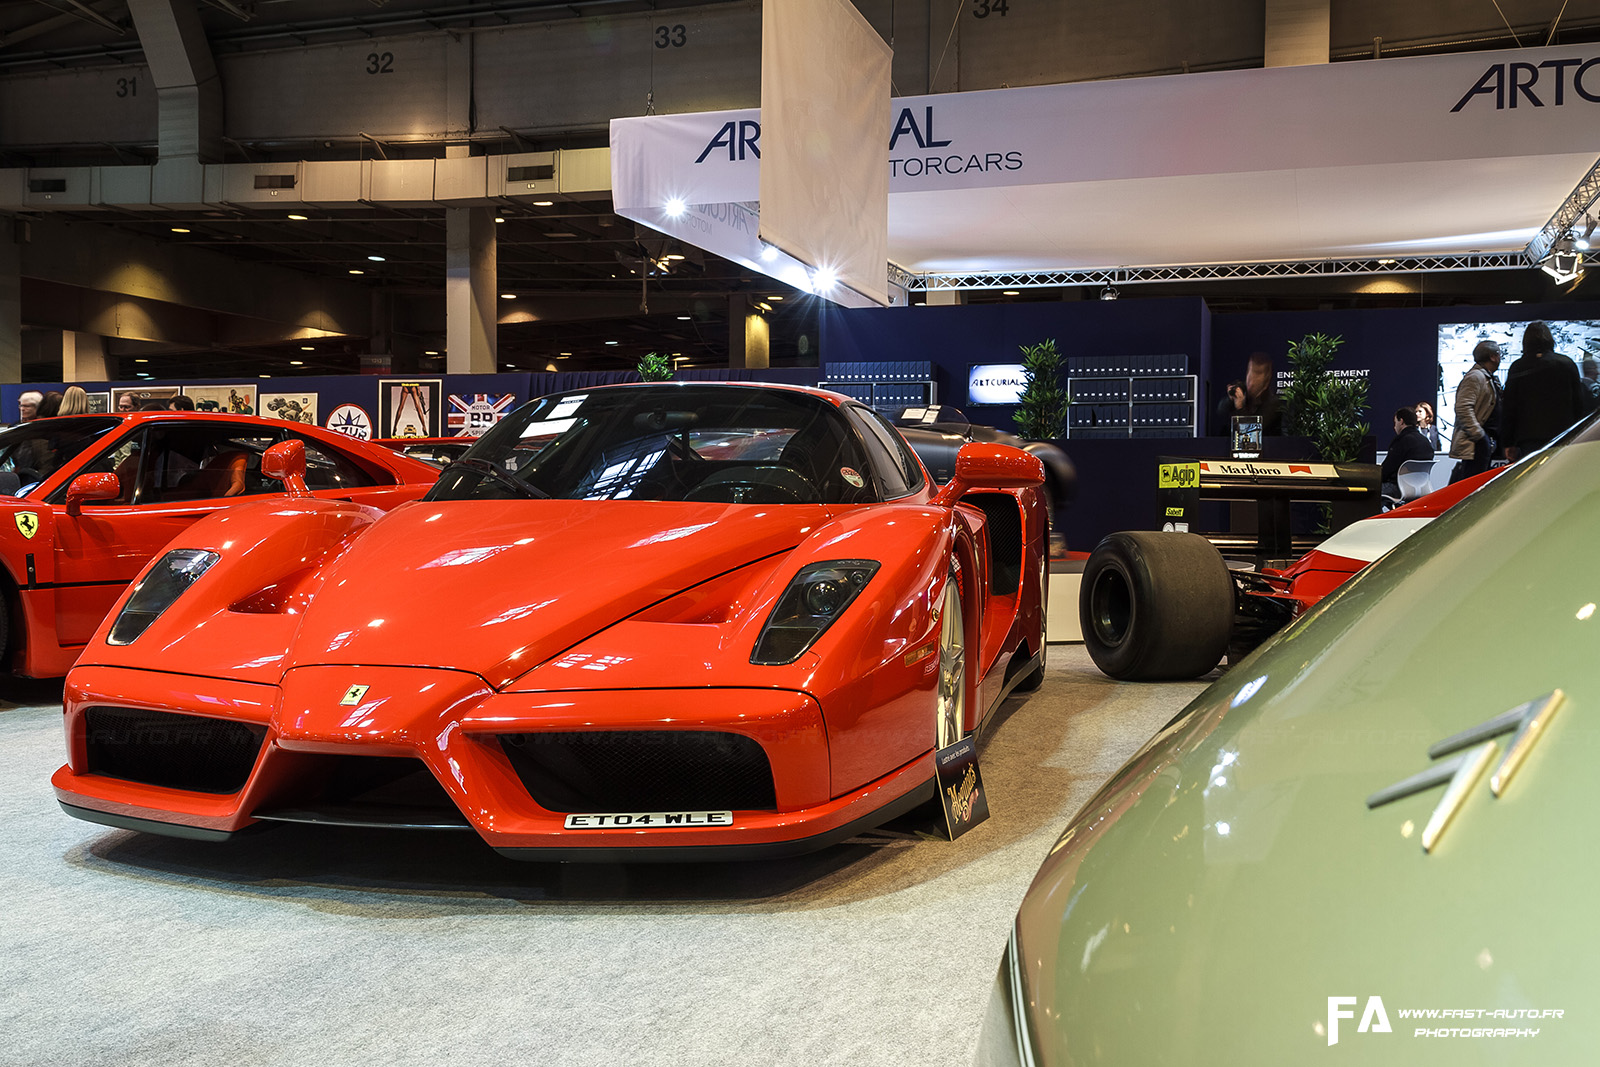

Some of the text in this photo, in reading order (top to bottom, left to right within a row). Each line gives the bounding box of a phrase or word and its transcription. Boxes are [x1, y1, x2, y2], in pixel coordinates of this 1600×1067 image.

[973, 0, 1009, 18] 34
[654, 24, 687, 49] 33
[366, 52, 394, 75] 32
[116, 77, 138, 98] 31
[971, 378, 1020, 387] ARTCURIAL
[334, 426, 367, 440] ZUR
[1171, 465, 1195, 486] Agip
[1220, 464, 1281, 475] Marlboro
[665, 813, 727, 825] WLE
